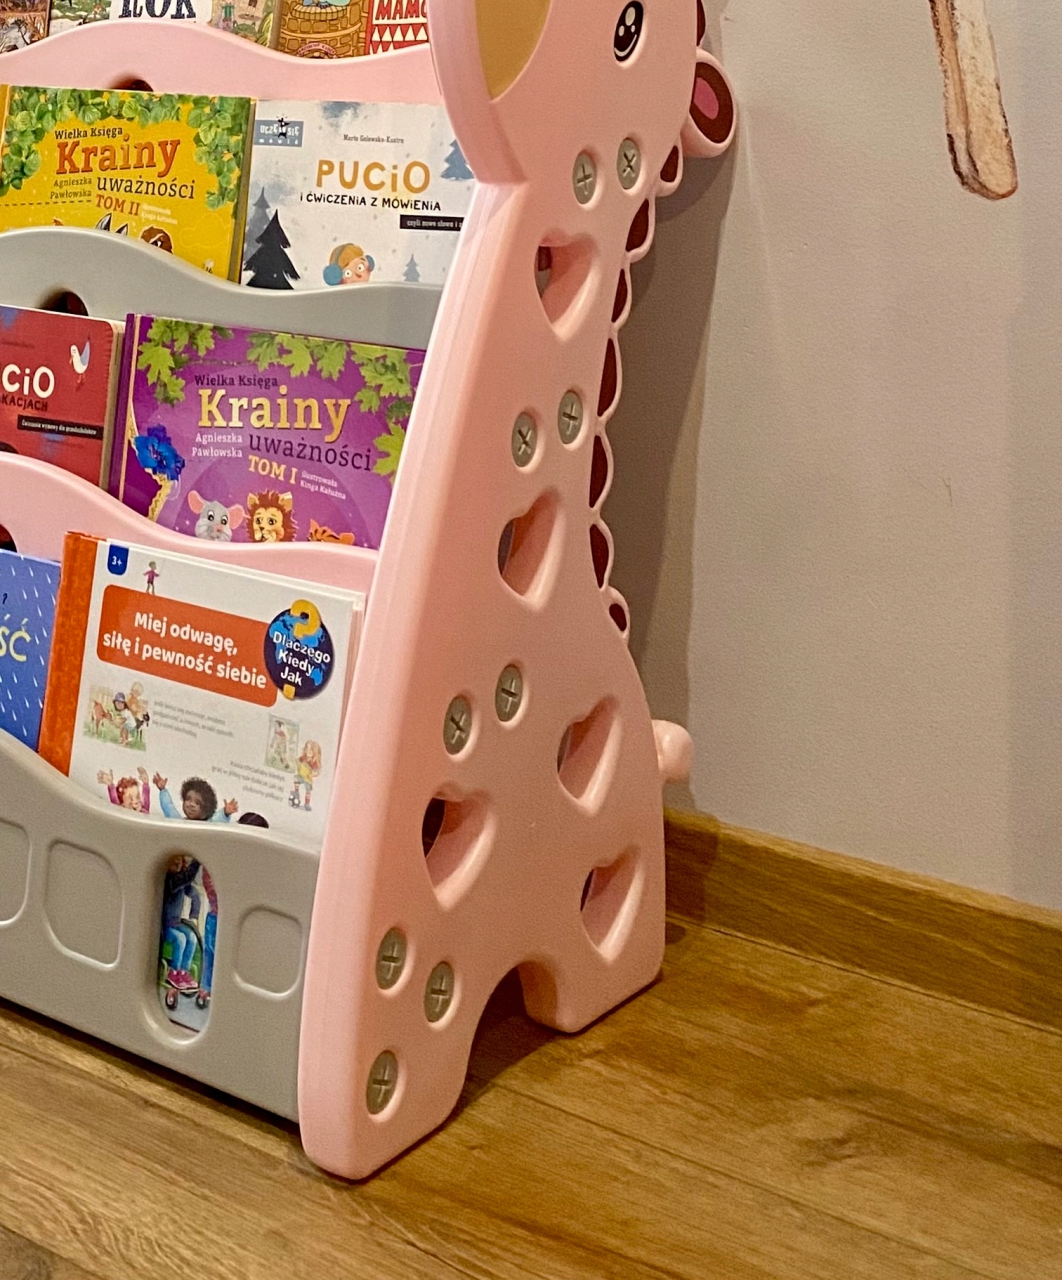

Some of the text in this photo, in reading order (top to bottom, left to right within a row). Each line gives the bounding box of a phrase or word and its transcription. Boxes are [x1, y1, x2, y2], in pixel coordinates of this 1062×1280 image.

[54, 126, 123, 140] Wielka Księga
[56, 133, 181, 178] Krainy
[50, 189, 92, 200] Pawłowska
[53, 177, 92, 190] Agnieszka
[97, 175, 196, 199] uważności
[96, 194, 125, 214] TOM
[130, 201, 140, 216] II
[371, 197, 378, 207] Z
[195, 375, 278, 389] Wielka Księga
[198, 385, 351, 443] Krainy
[195, 432, 242, 446] Agnieszka
[192, 447, 242, 457] Pawłowska
[249, 433, 372, 471] uważności
[248, 455, 297, 484] TOM I
[111, 555, 123, 567] 3+
[134, 612, 238, 656] Miej odwagę,
[272, 630, 331, 664] Dlaczego
[103, 631, 267, 689] siłę i pewność siebie
[278, 649, 314, 677] Kiedy
[280, 666, 303, 686] Jak
